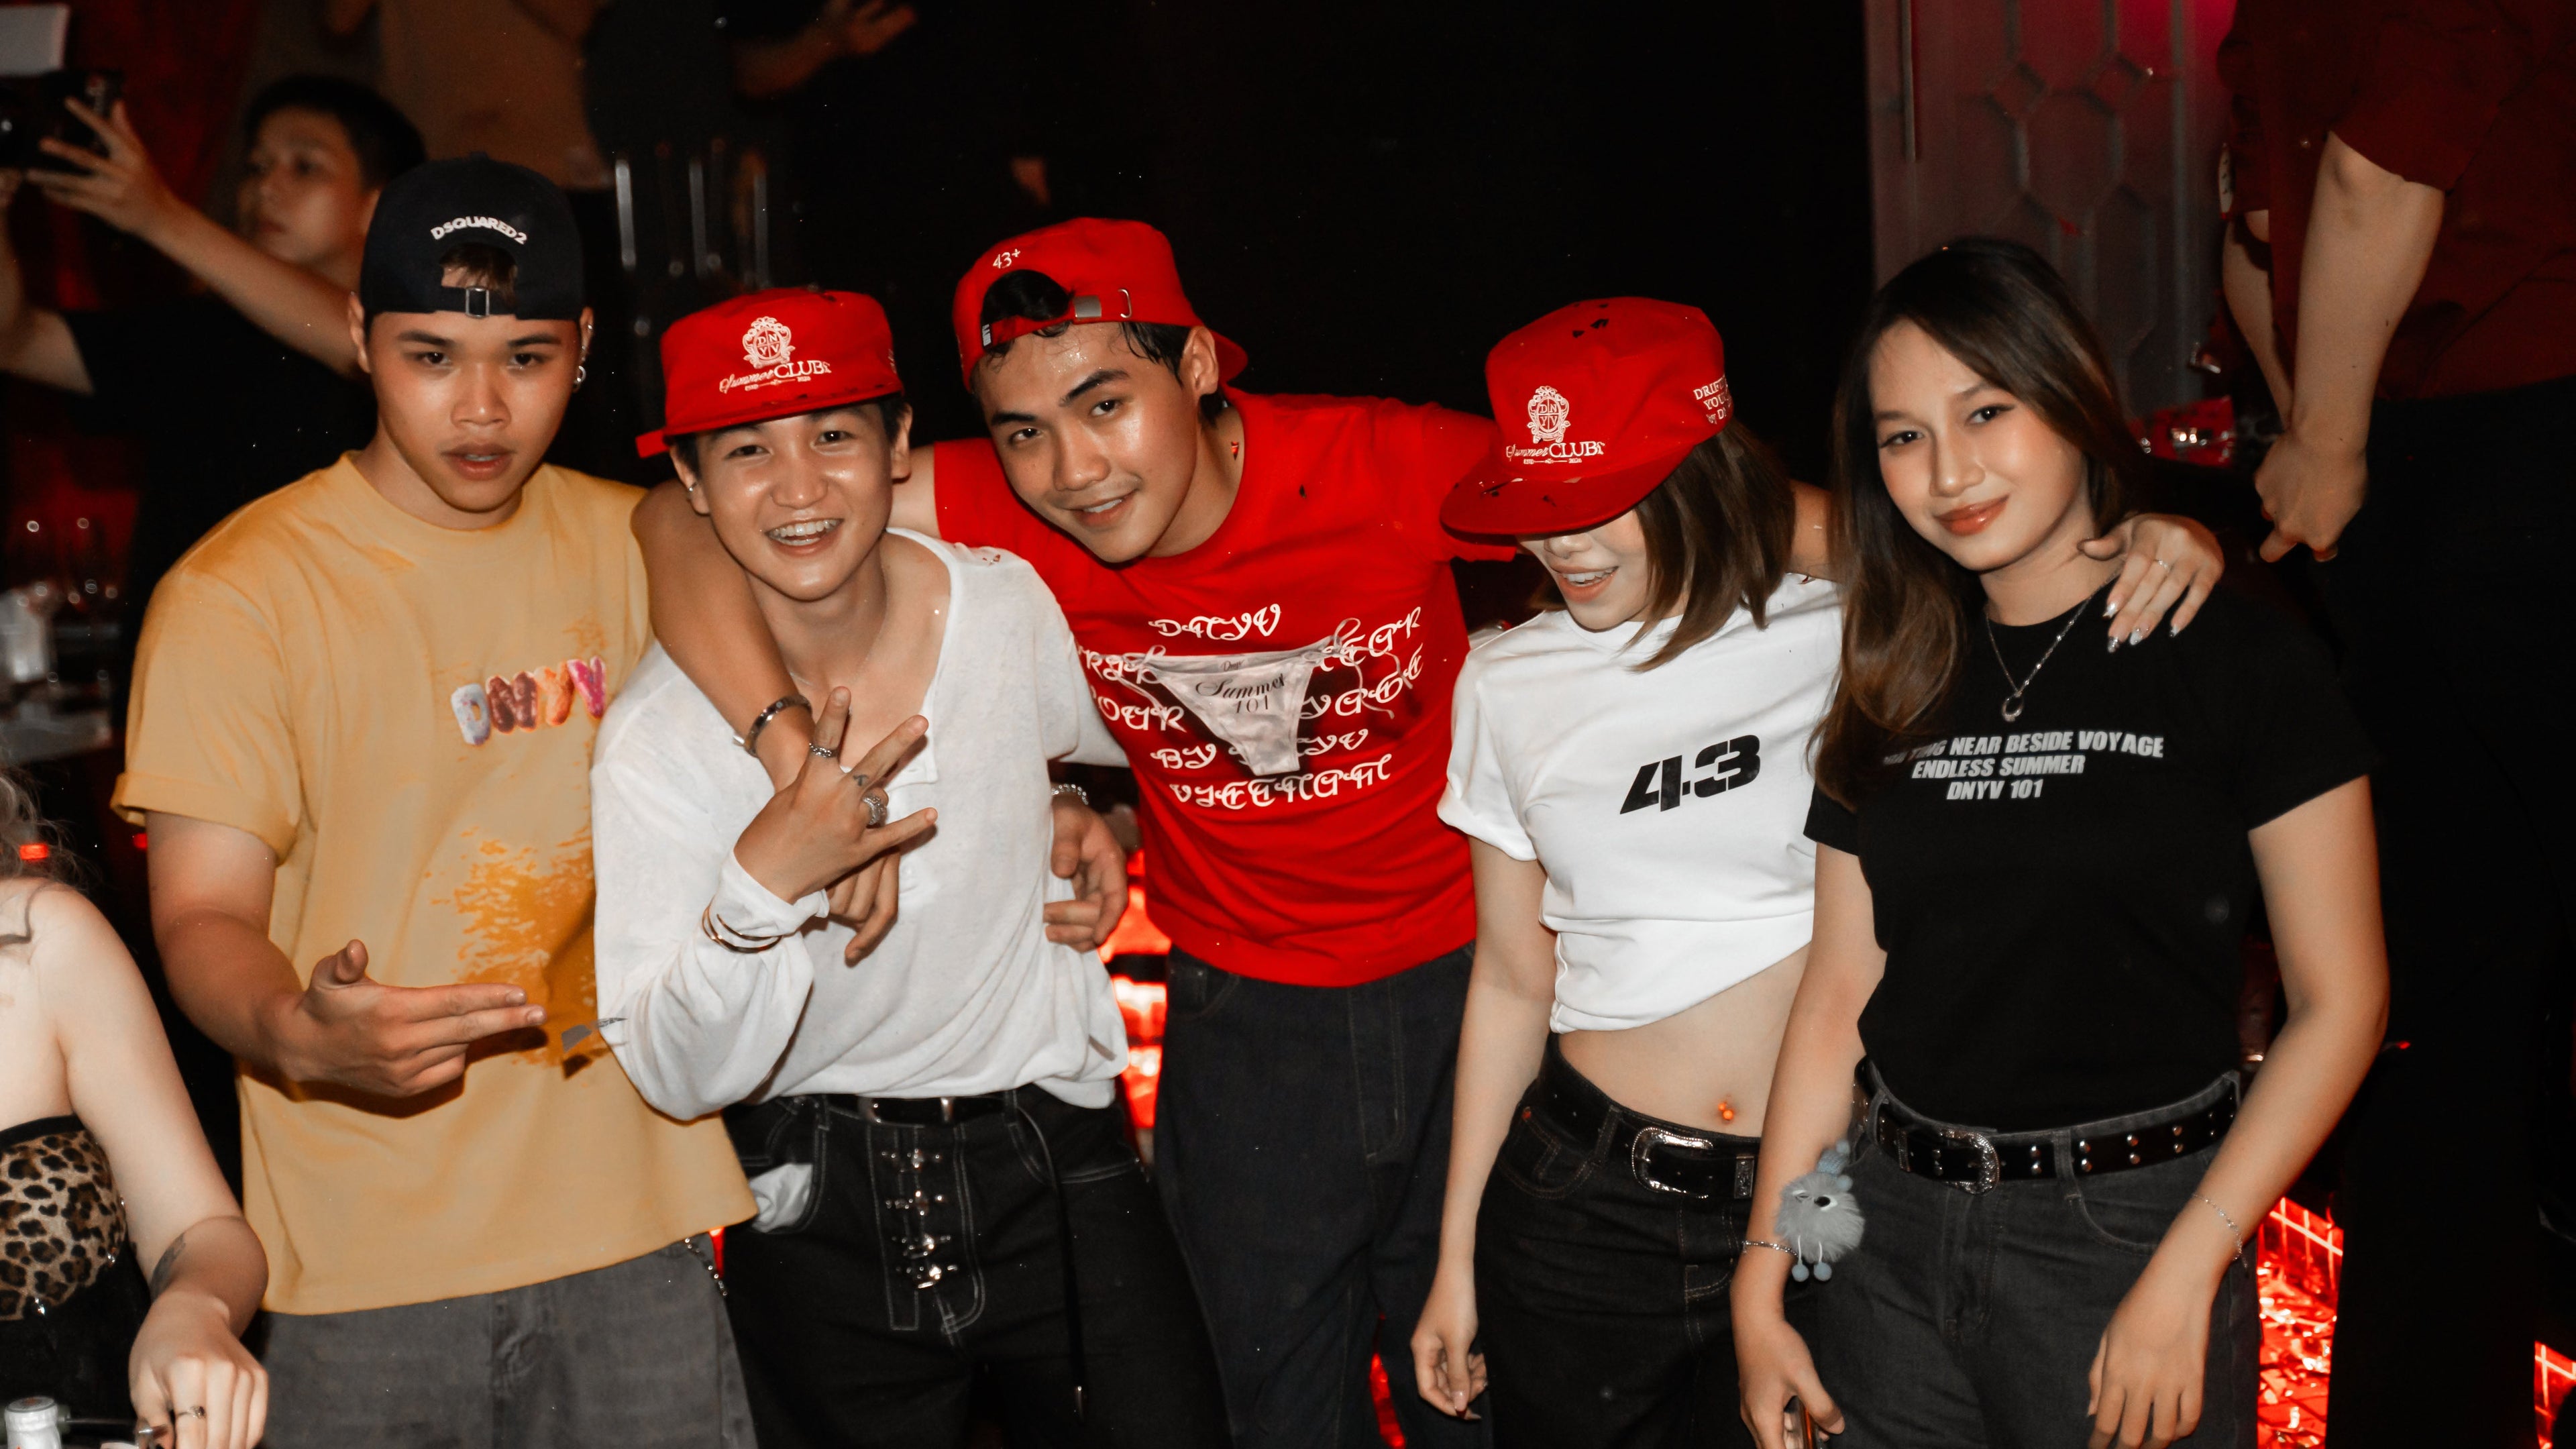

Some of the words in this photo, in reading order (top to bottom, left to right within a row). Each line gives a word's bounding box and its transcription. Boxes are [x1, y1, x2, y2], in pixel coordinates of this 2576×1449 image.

[430, 216, 527, 245] DSQUARED2
[993, 249, 1020, 268] 43+
[1195, 674, 1284, 699] Summer
[1236, 694, 1269, 714] 101
[1949, 736, 2002, 756] NEAR
[2004, 732, 2072, 753] BESIDE
[2078, 731, 2165, 759] VOYAGE
[1619, 735, 1760, 814] 43
[1911, 758, 1996, 779] ENDLESS
[1999, 755, 2086, 775] SUMMER
[1946, 780, 2005, 800] DNYV
[2010, 779, 2043, 799] 101
